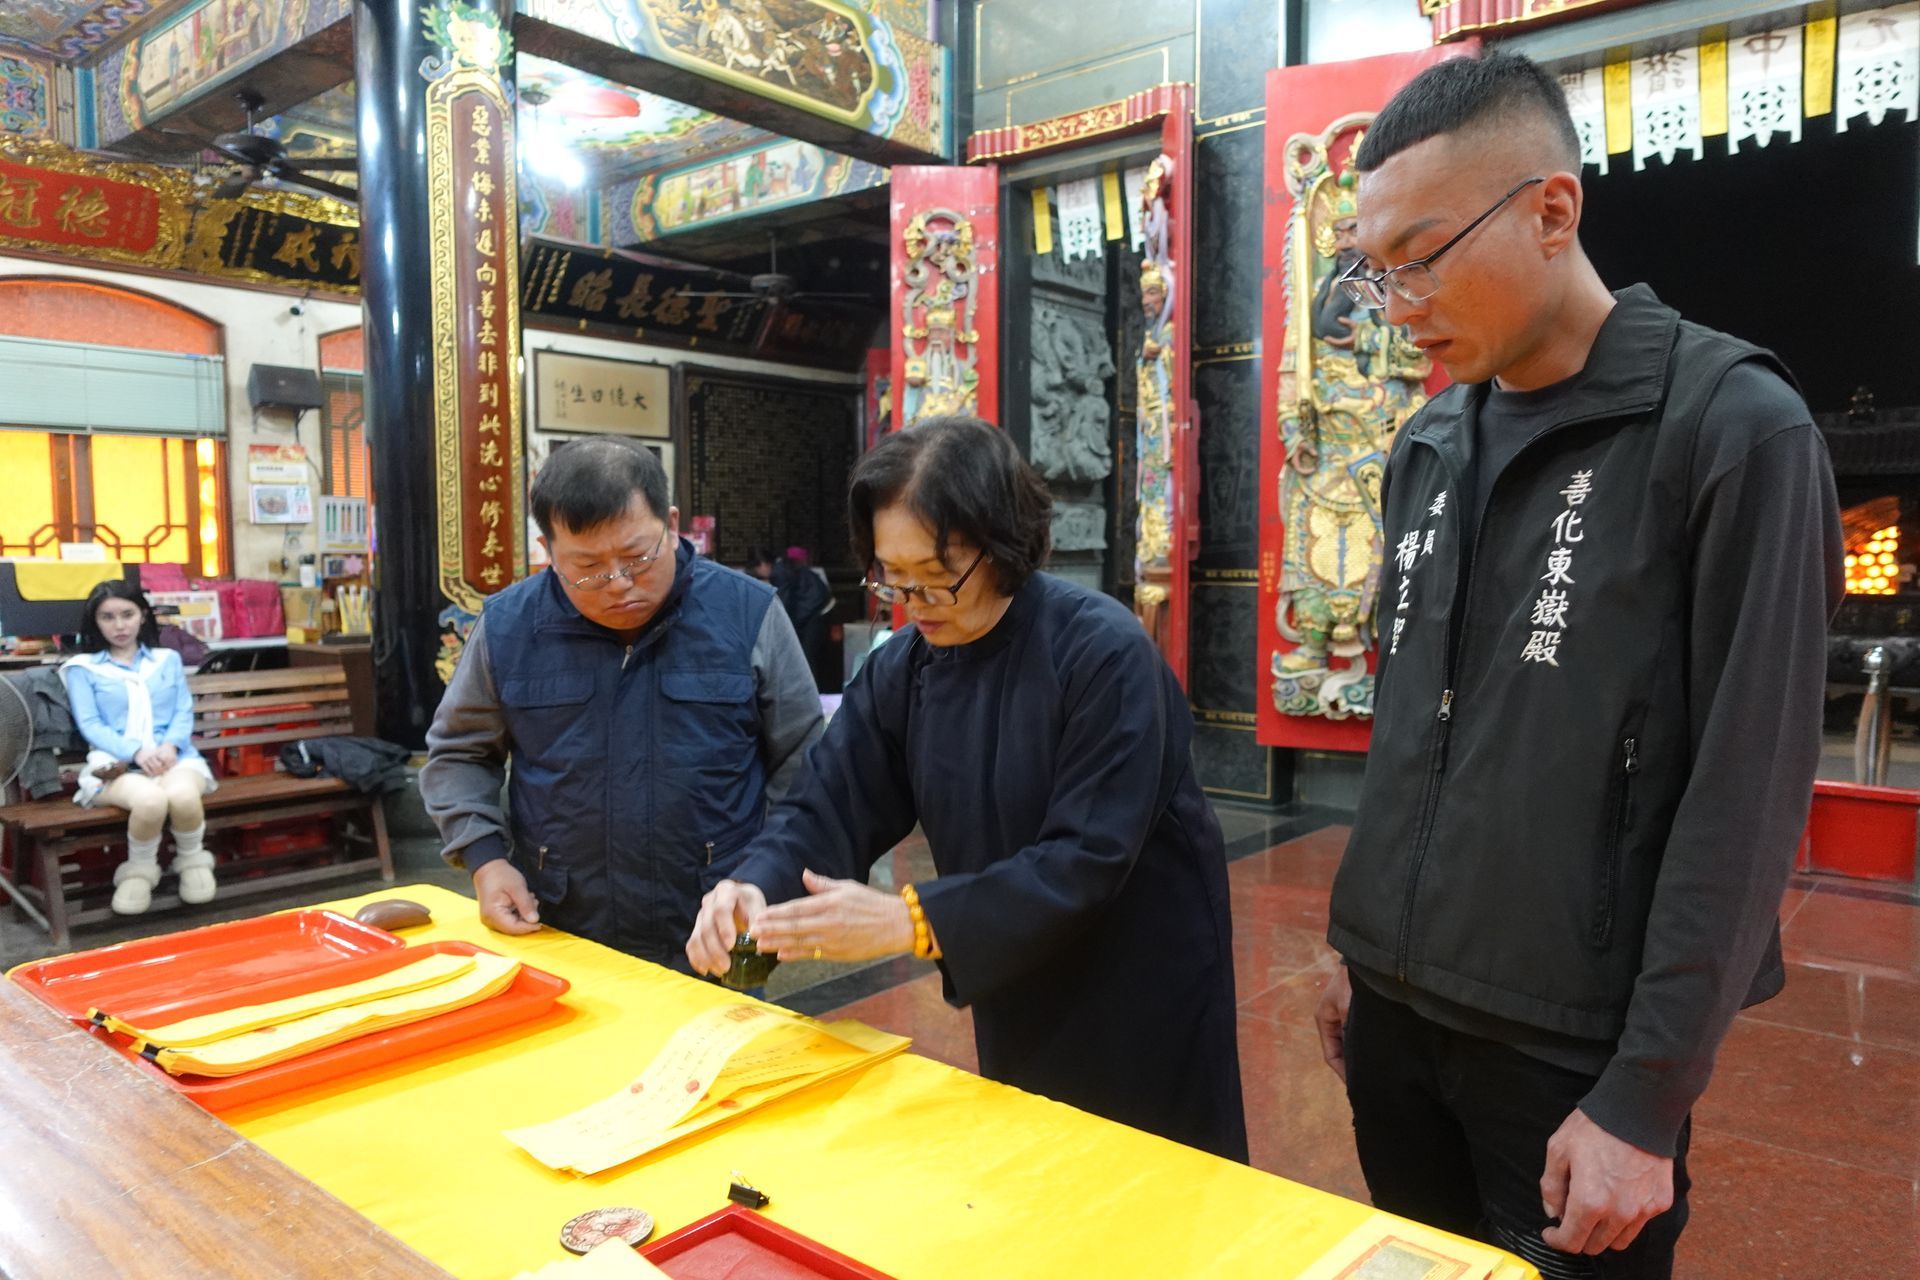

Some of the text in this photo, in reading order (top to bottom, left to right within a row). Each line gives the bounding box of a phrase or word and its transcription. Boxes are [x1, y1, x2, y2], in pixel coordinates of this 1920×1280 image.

[1420, 490, 1447, 556] 委員
[1519, 468, 1593, 668] 善化東嶽殿
